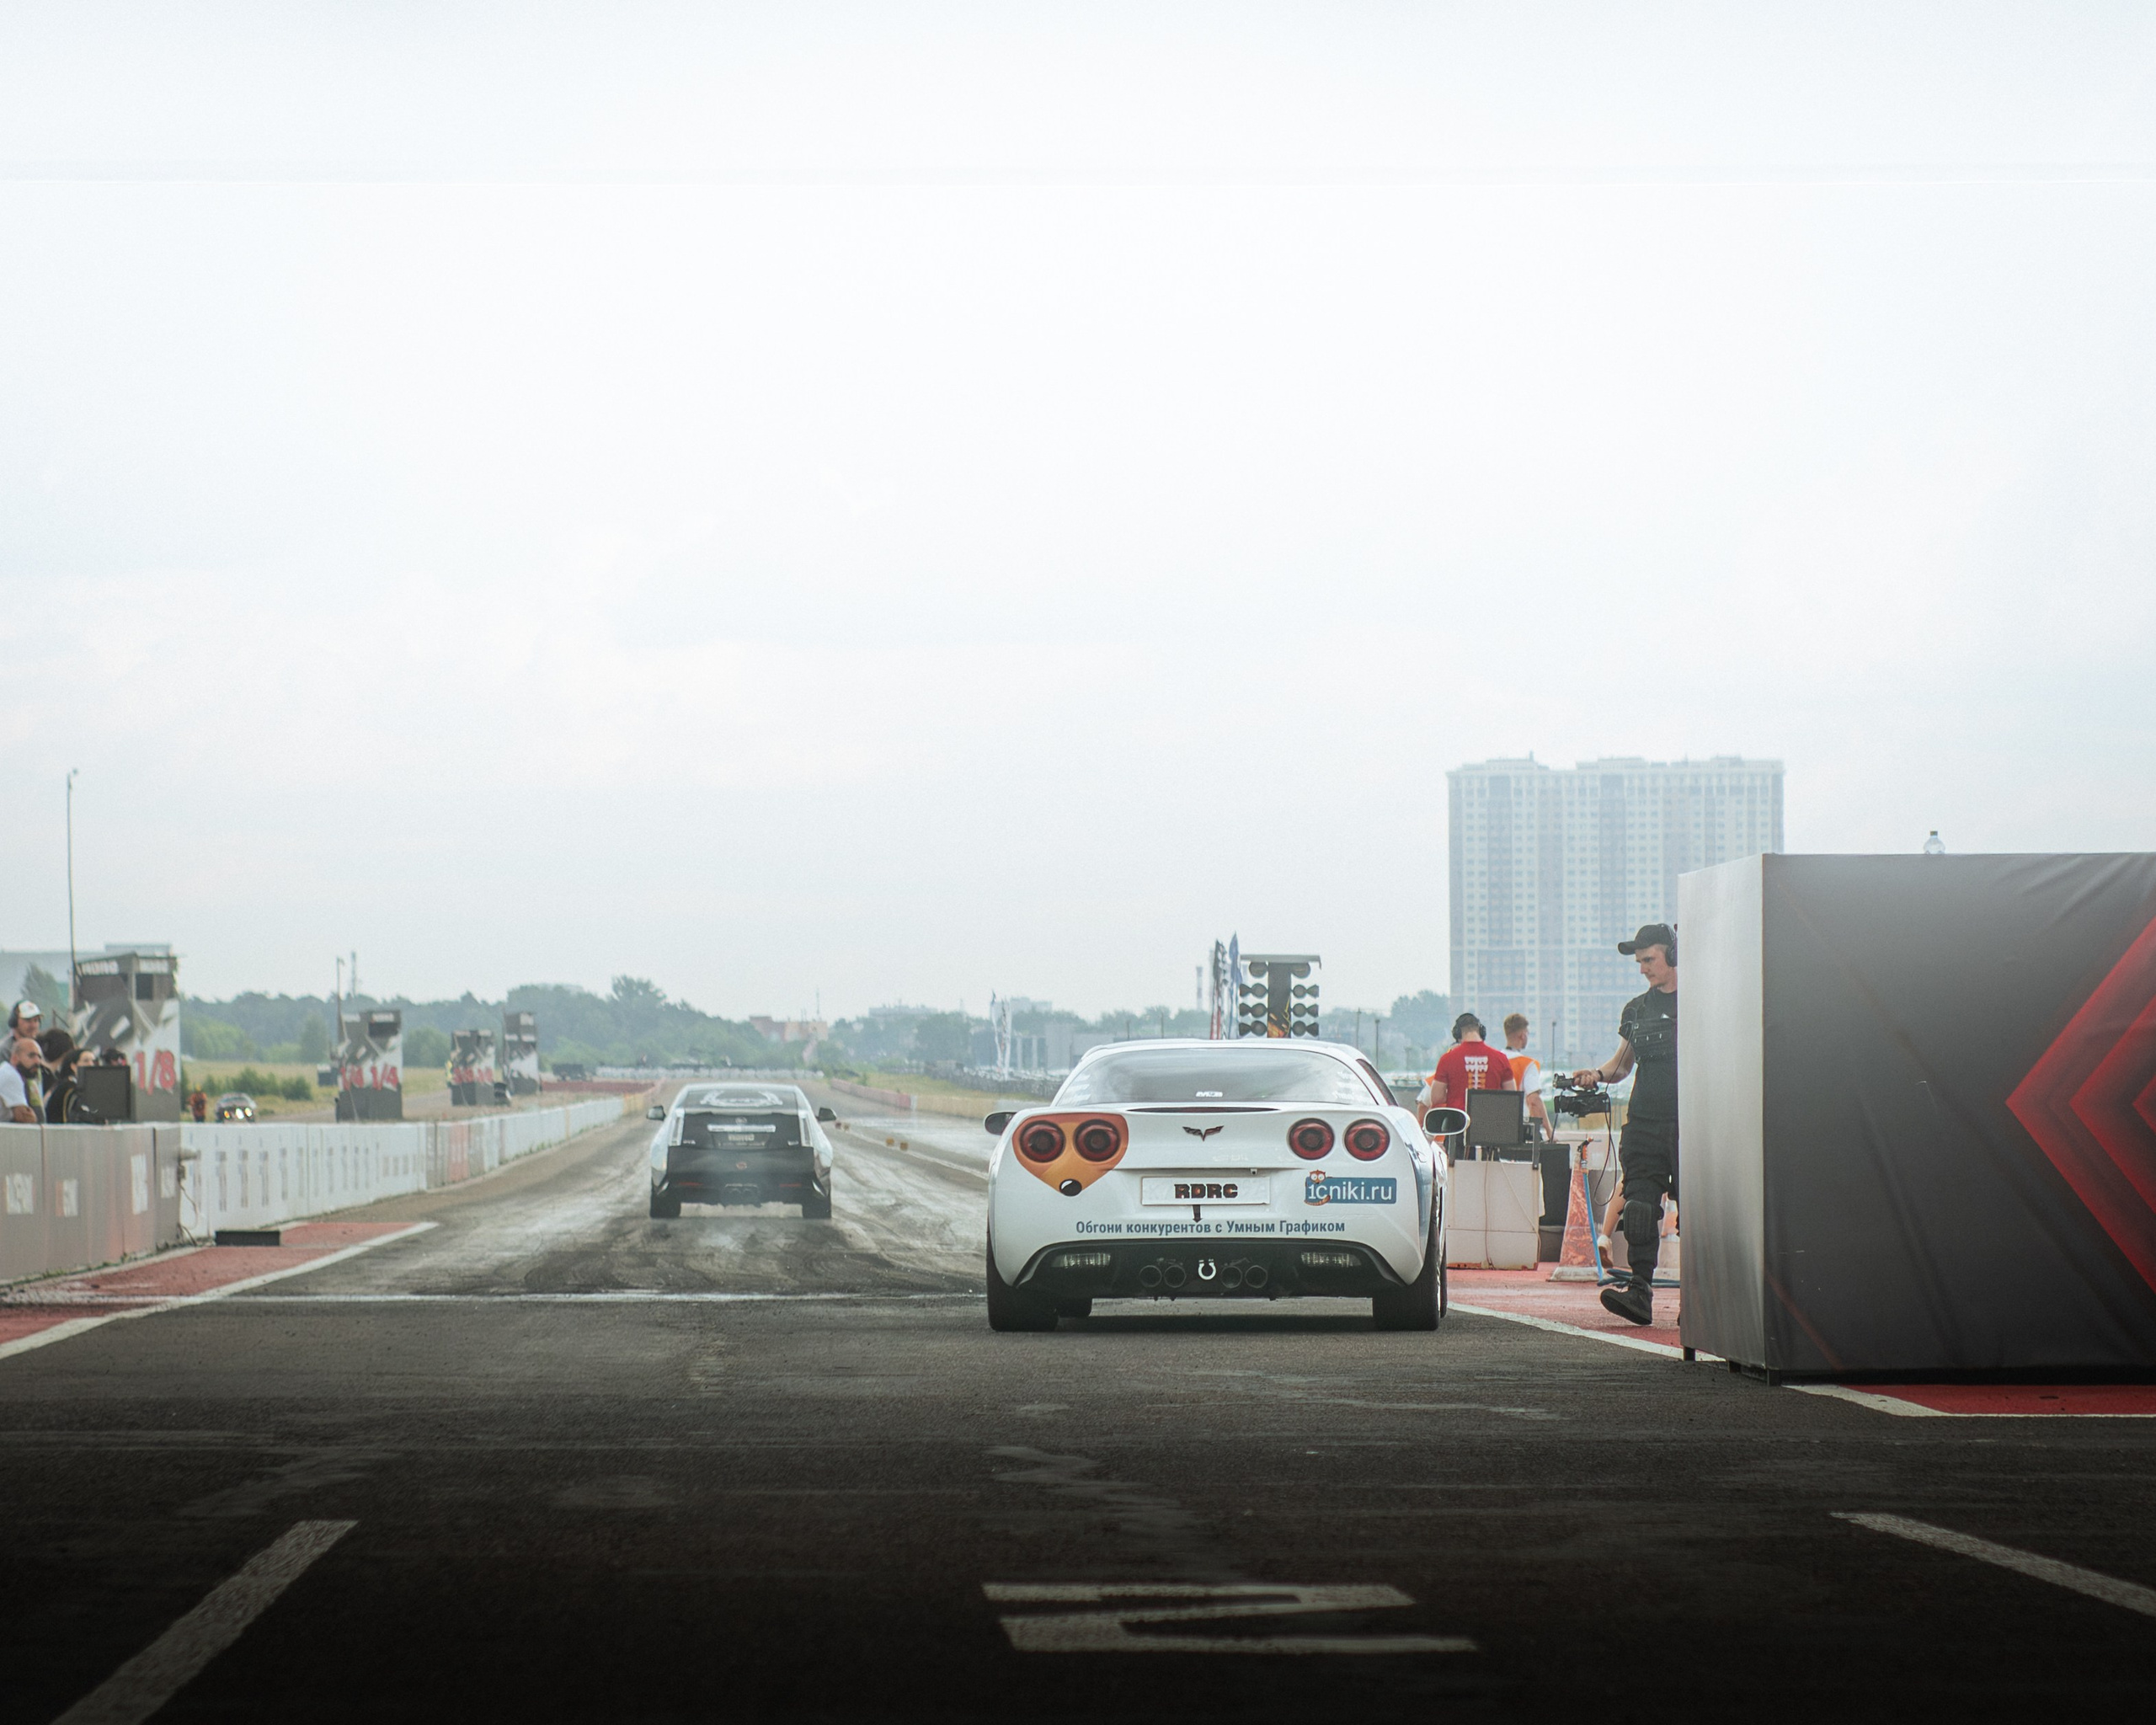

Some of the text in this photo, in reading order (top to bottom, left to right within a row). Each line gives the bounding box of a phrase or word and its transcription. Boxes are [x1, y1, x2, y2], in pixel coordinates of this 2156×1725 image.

[134, 1049, 176, 1096] 1/8
[1174, 1183, 1238, 1199] RDRC
[1307, 1181, 1393, 1200] 1cniki.ru
[1075, 1220, 1345, 1236] Обгони конкурентов с Умным Графиком
